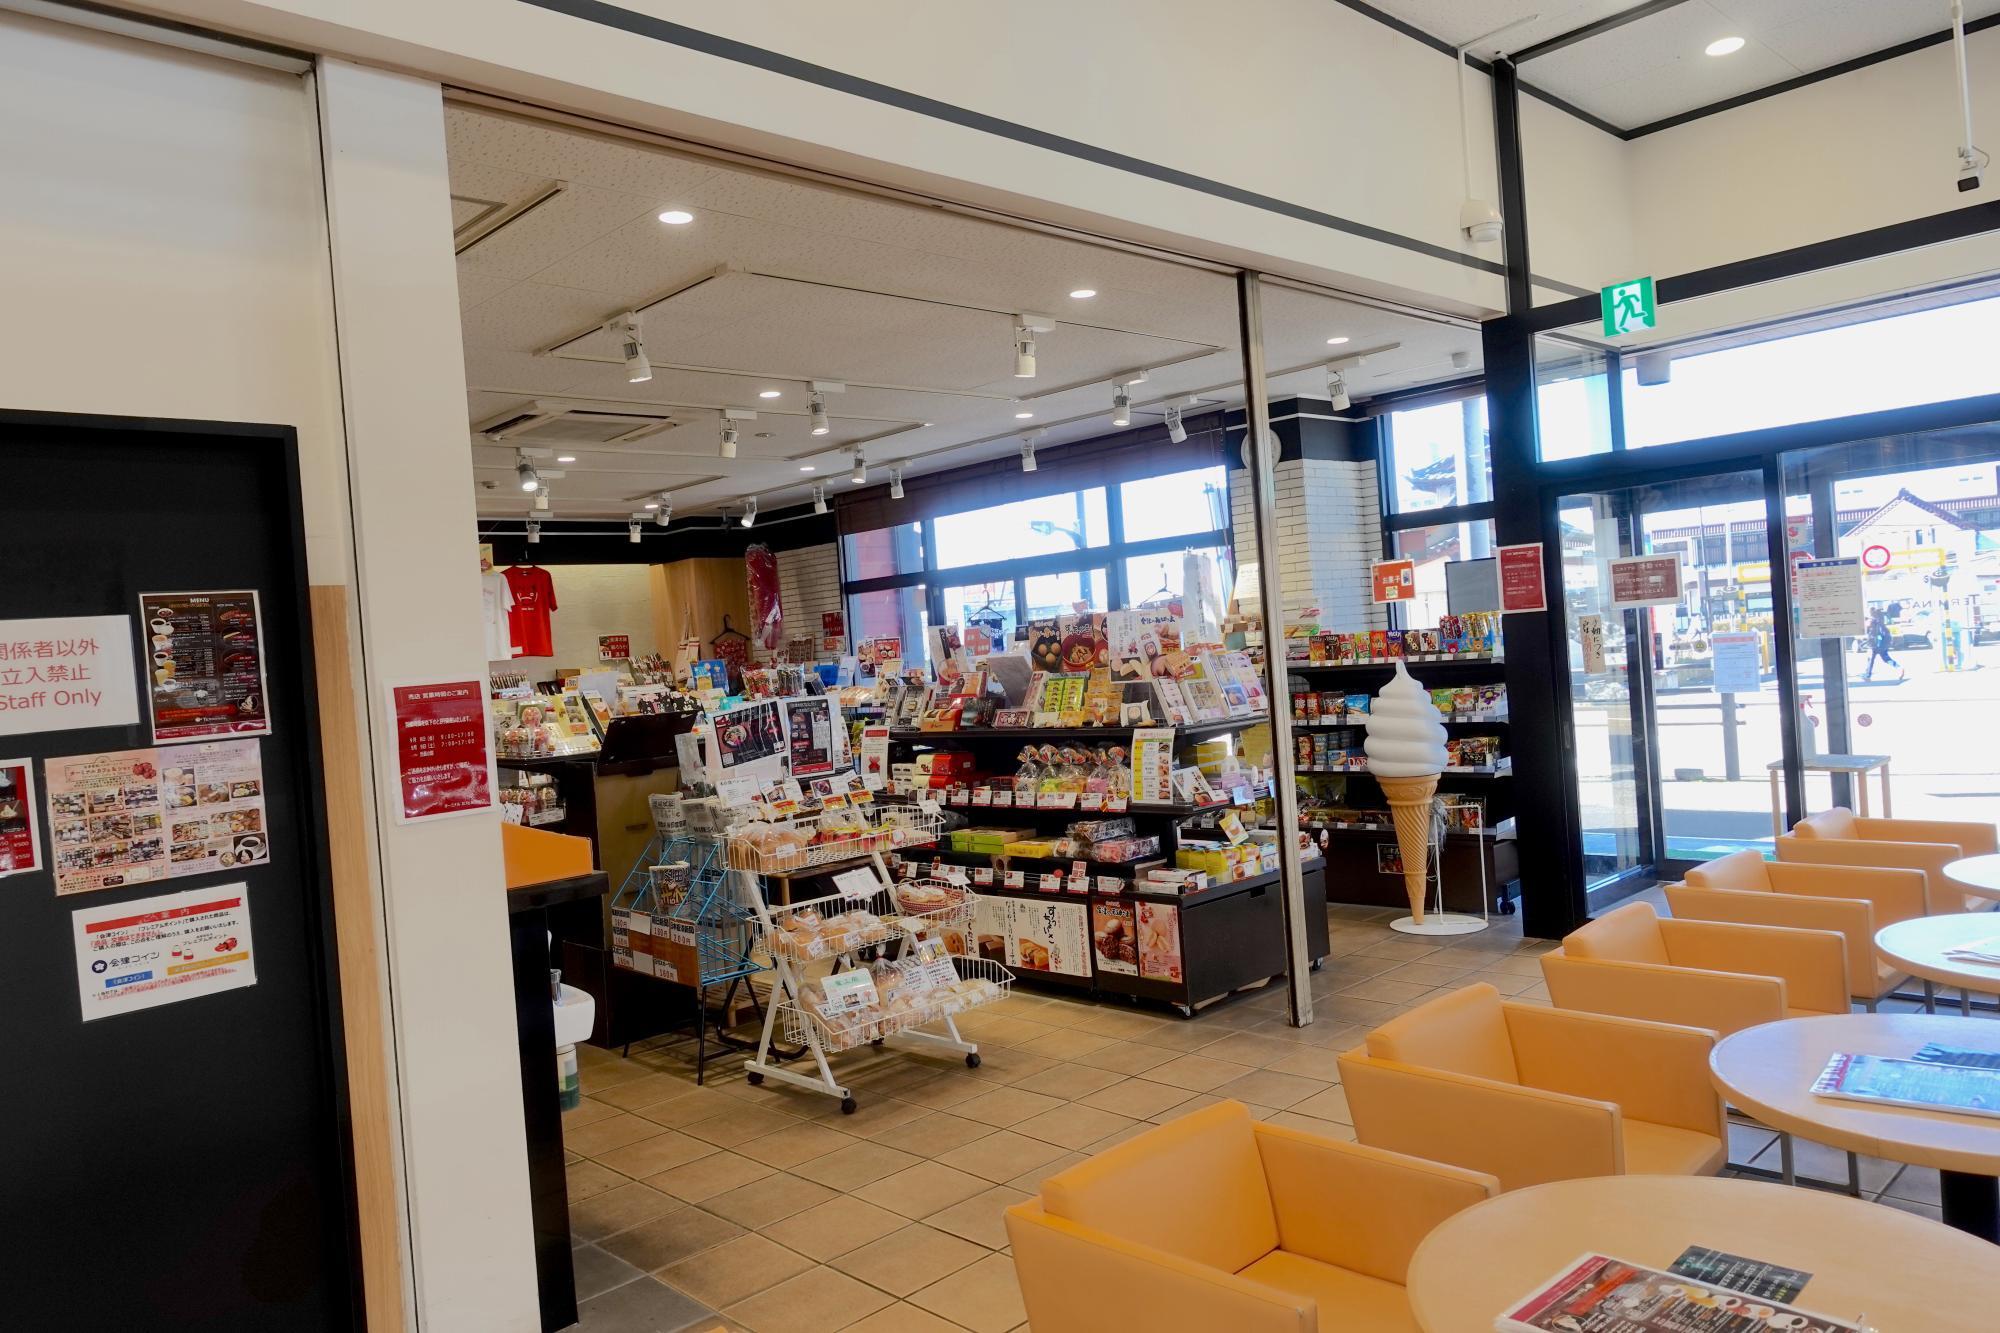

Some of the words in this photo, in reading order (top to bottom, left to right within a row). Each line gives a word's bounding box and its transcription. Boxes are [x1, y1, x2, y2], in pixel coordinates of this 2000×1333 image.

[1, 664, 92, 686] 立入禁止
[0, 691, 47, 711] Staff
[54, 688, 102, 707] Only
[1348, 757, 1367, 768] DAR
[109, 952, 160, 966] 会津コイン
